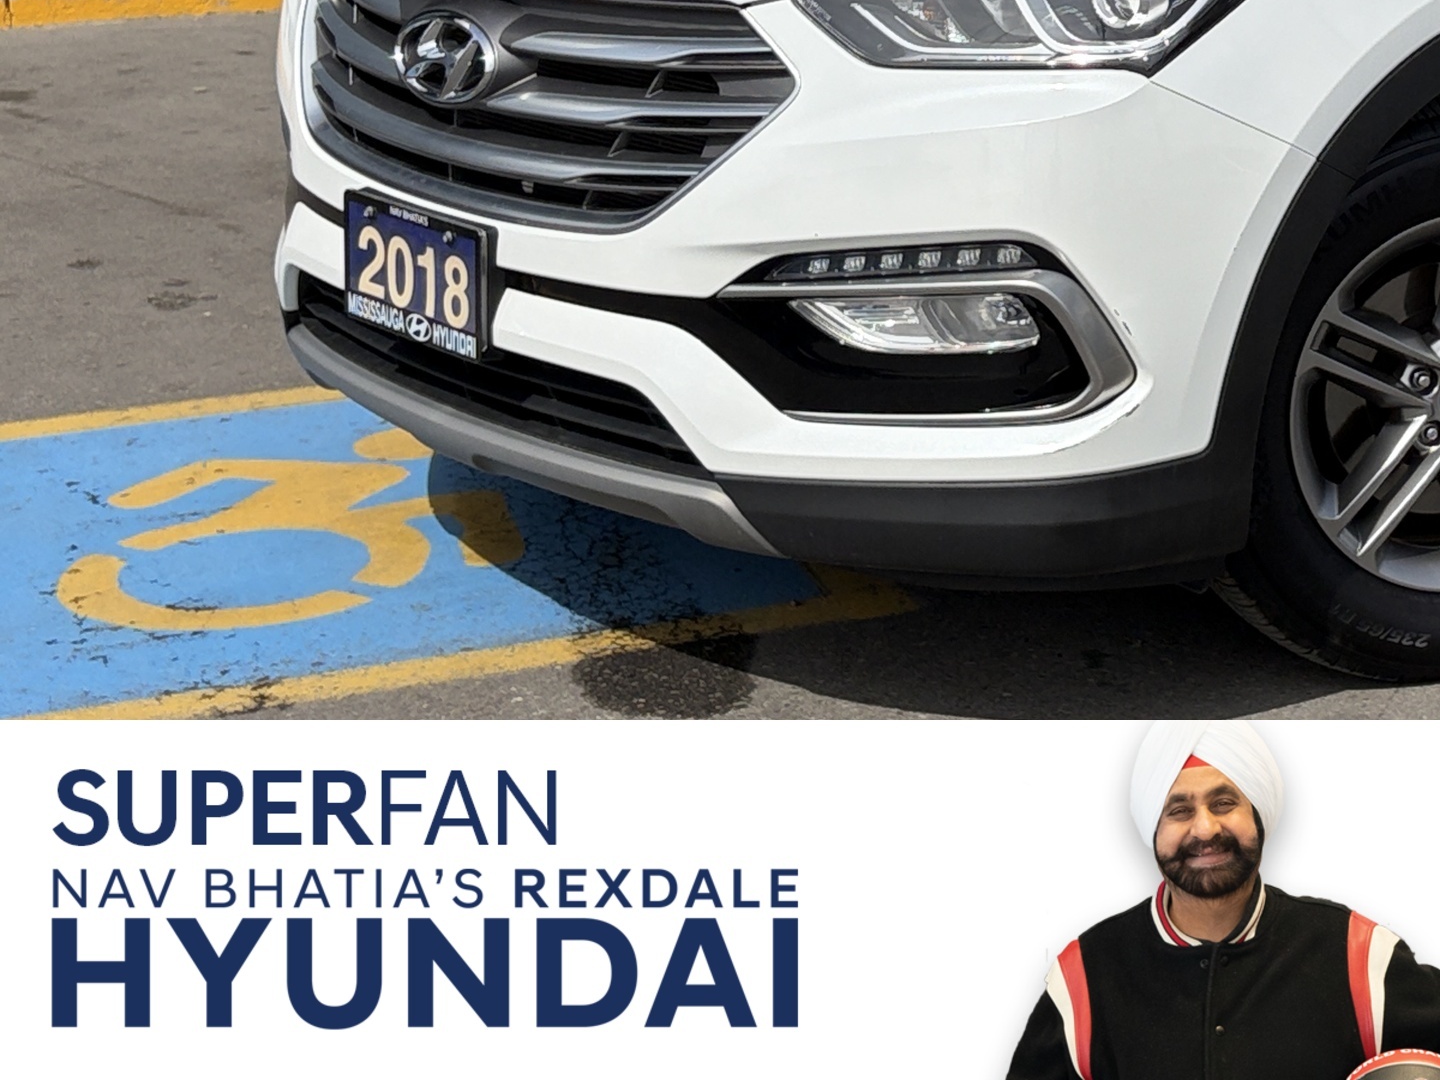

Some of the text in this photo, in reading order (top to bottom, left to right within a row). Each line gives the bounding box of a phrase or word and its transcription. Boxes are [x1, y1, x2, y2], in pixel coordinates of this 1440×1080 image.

[358, 225, 470, 330] 2018
[347, 291, 477, 359] MISSISSAUGA HYUNDAI
